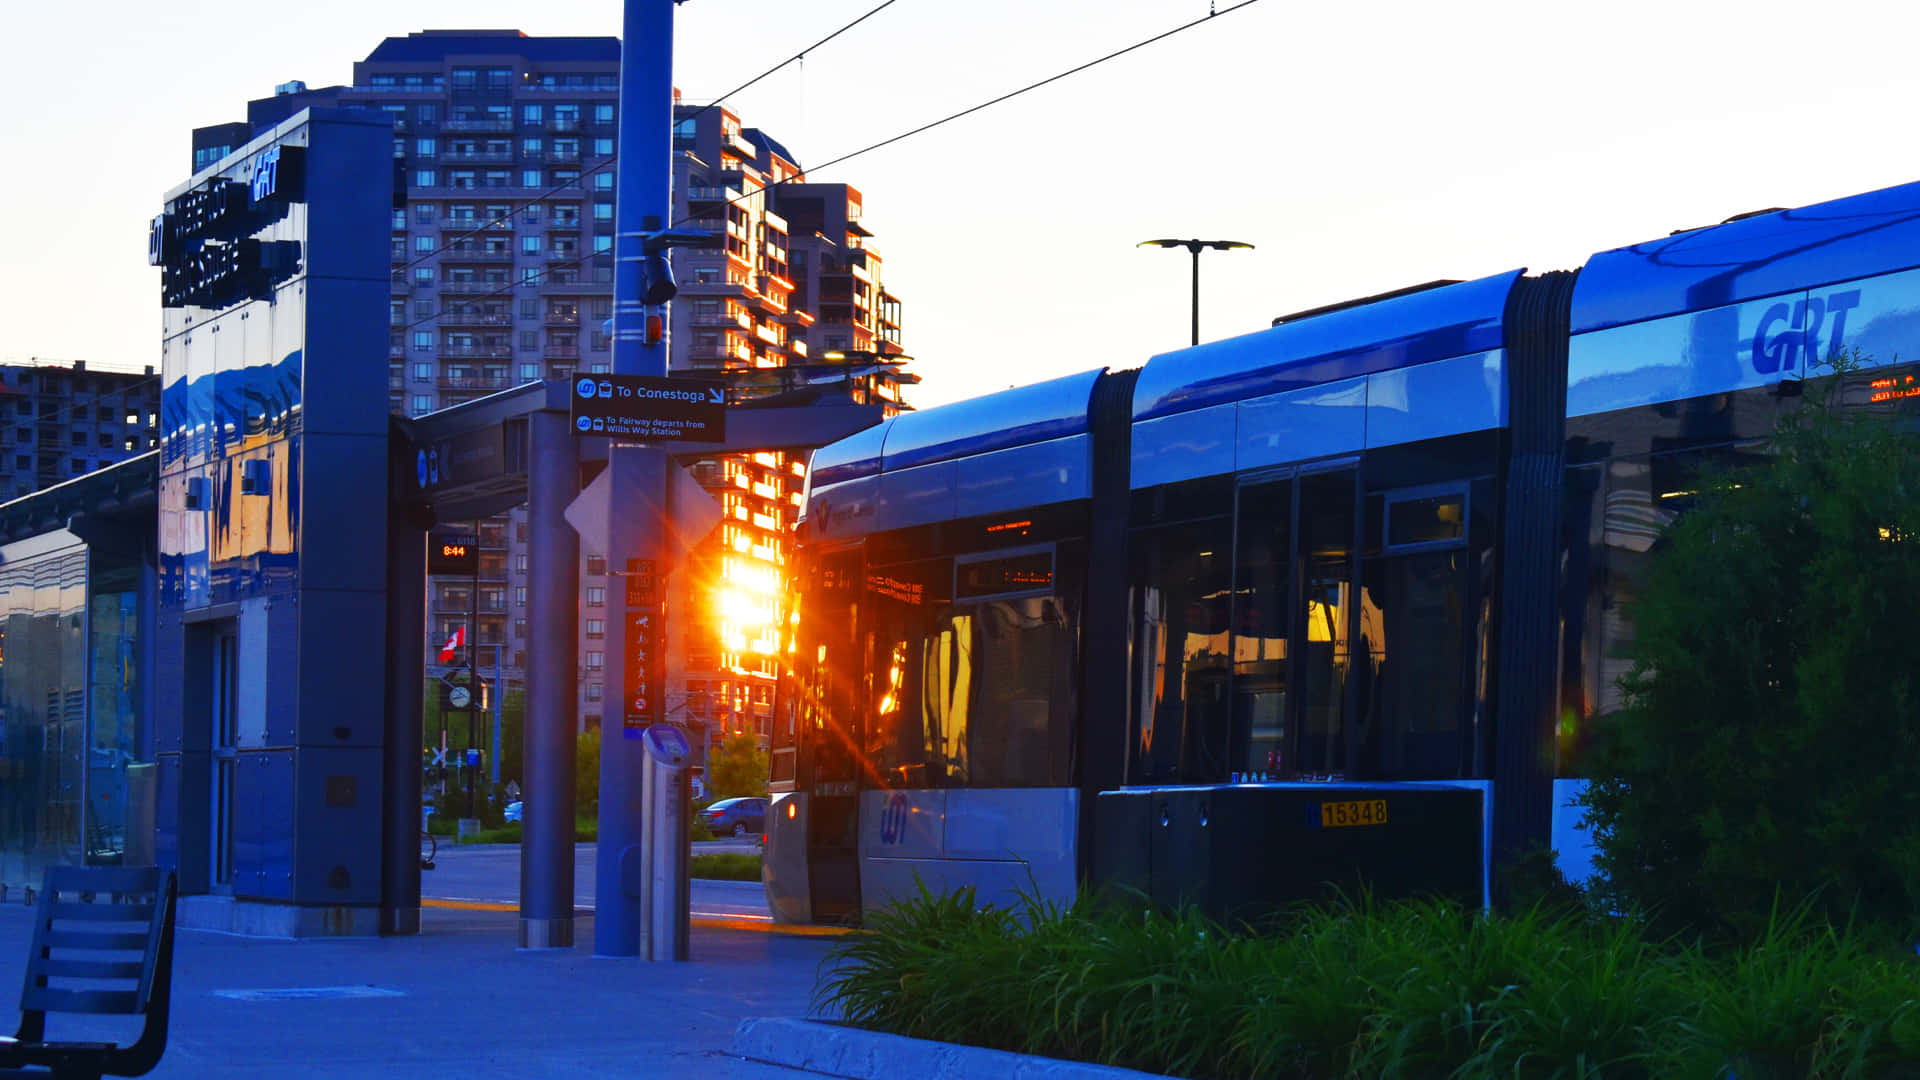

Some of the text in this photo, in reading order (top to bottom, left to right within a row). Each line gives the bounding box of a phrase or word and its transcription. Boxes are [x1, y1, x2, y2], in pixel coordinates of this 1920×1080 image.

[1753, 292, 1861, 374] GRT
[617, 386, 631, 397] To
[637, 387, 705, 403] Conestoga
[606, 416, 616, 424] To
[619, 417, 650, 427] Fairway
[652, 418, 684, 429] departs
[686, 420, 705, 429] from
[607, 425, 681, 436] Willis Way Station
[443, 545, 465, 558] 8:44
[1322, 801, 1386, 825] 15348
